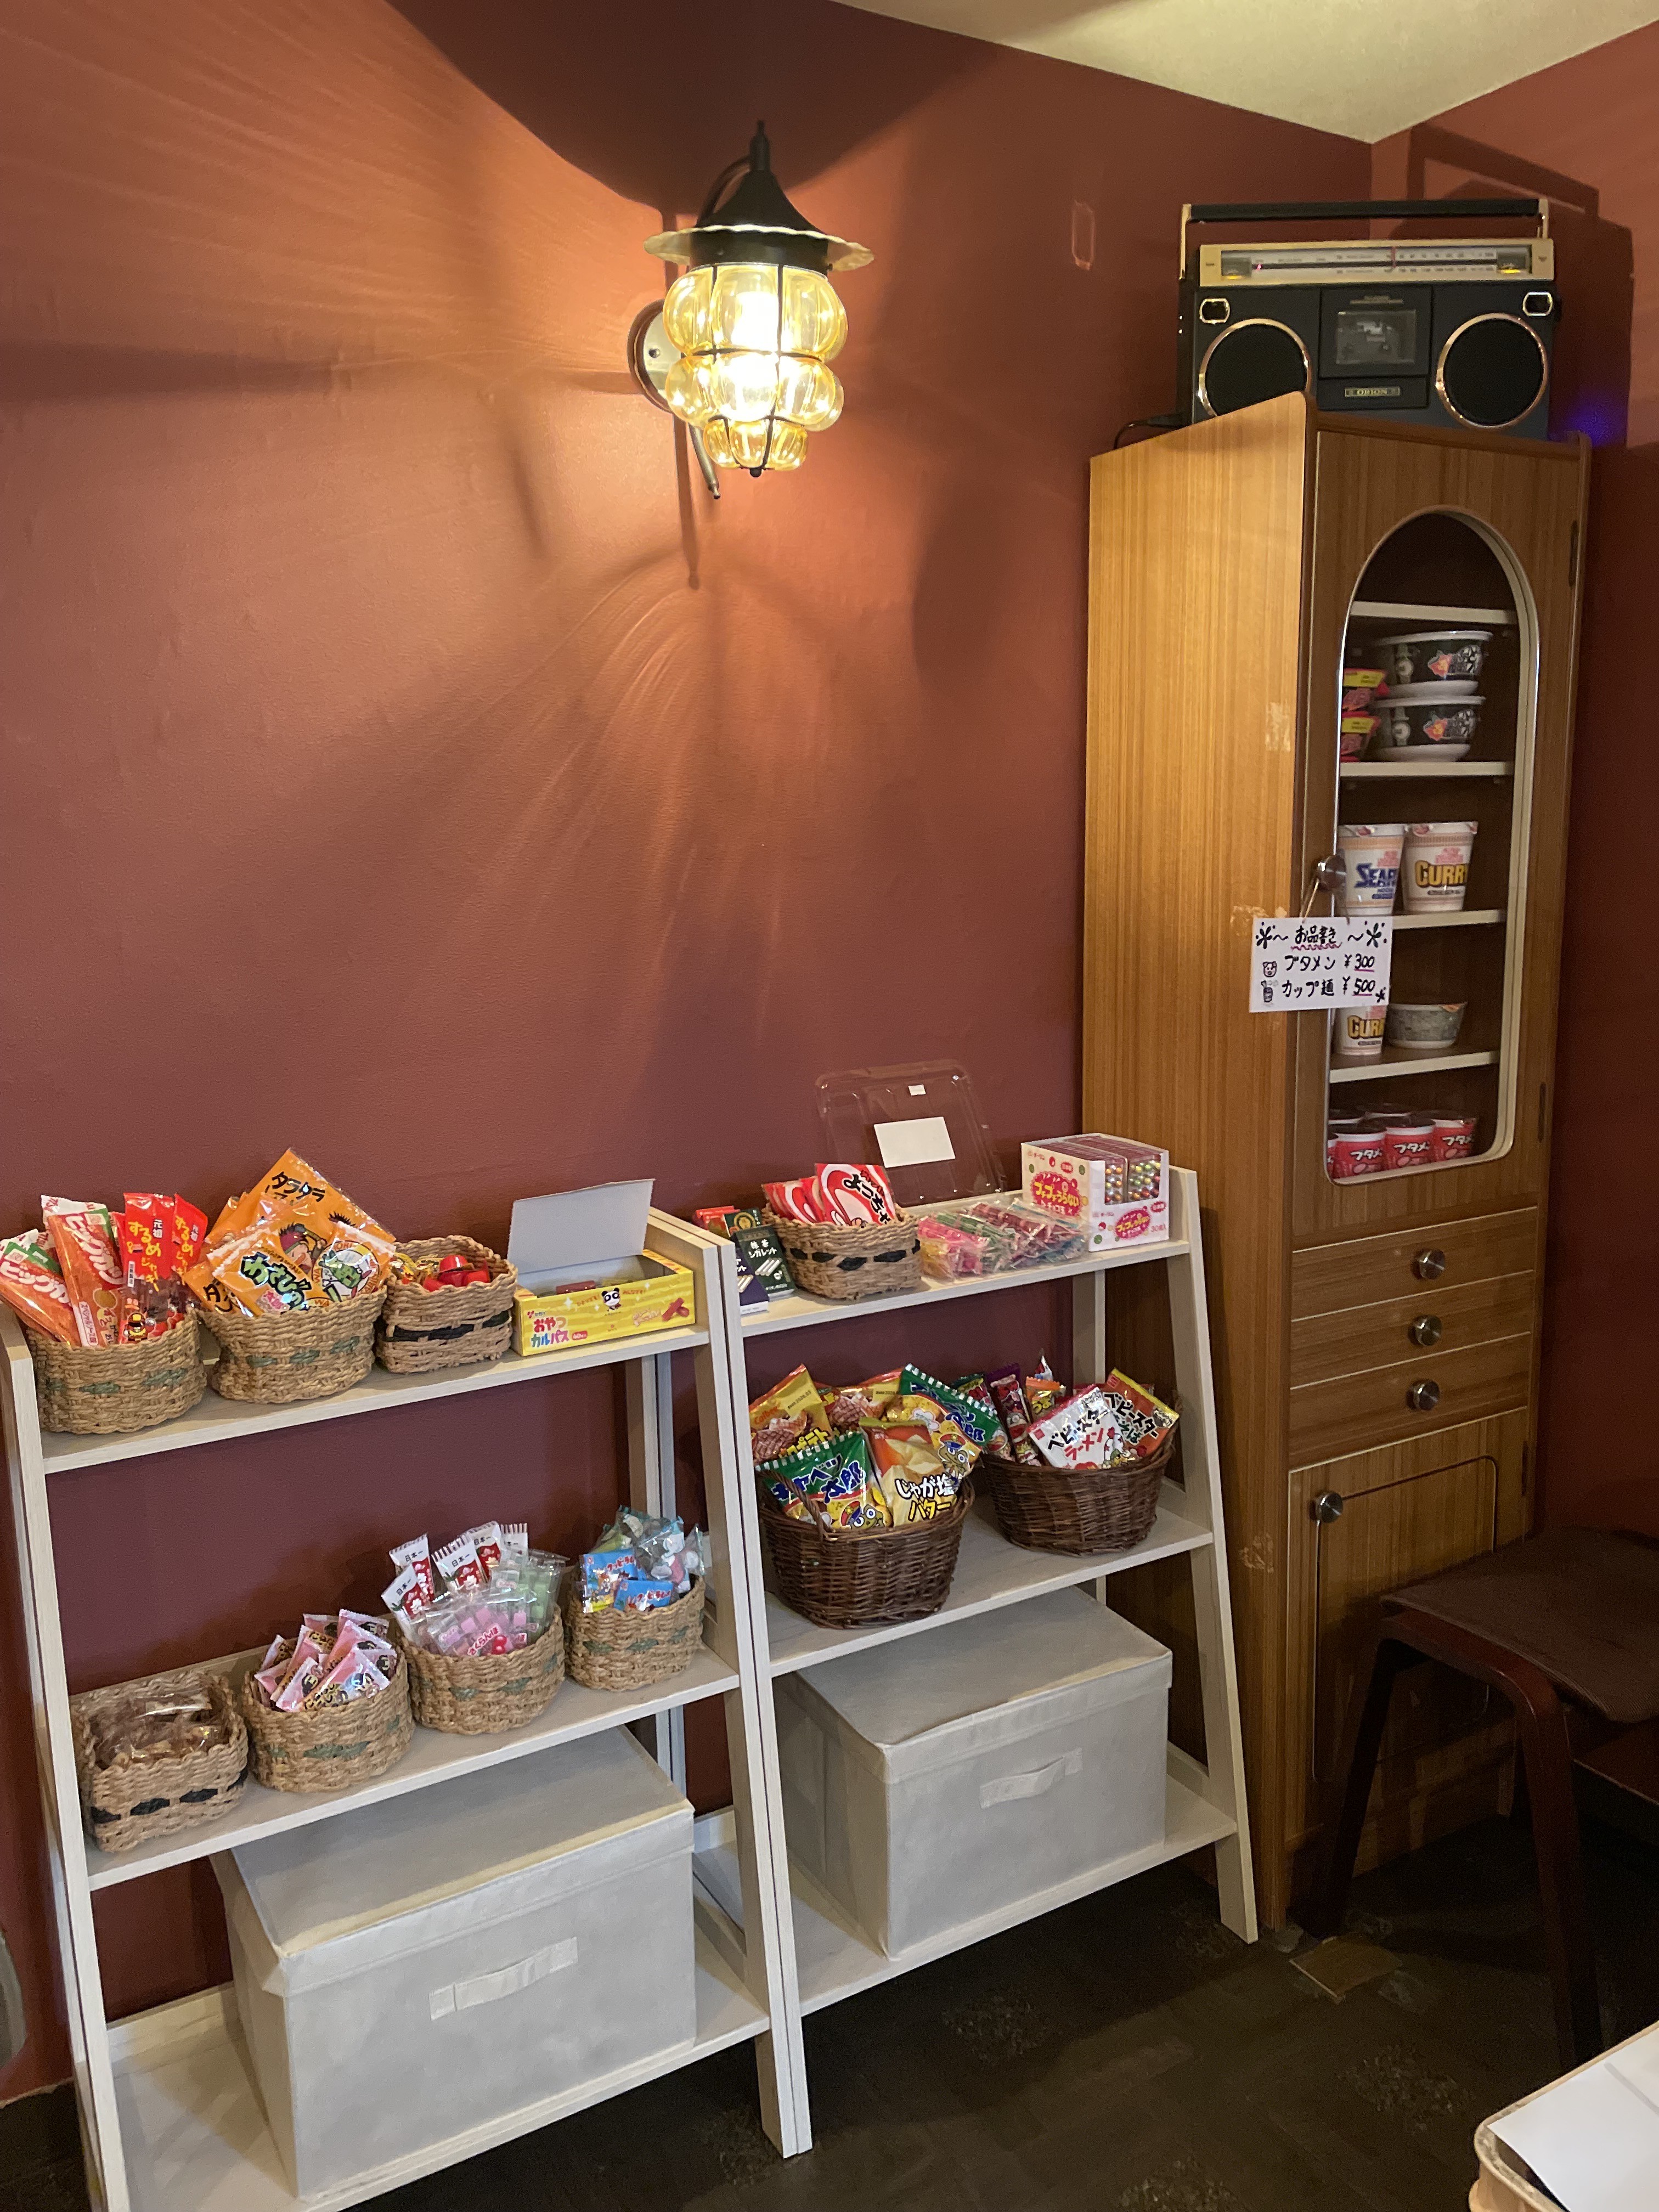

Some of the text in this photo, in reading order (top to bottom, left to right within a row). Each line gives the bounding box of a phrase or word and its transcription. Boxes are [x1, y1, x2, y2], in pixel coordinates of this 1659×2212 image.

[1284, 955, 1335, 971] ブタメン
[1282, 978, 1334, 998] カップ麺
[272, 1171, 325, 1202] タラタラ
[128, 1221, 161, 1257] するめ
[175, 1215, 193, 1257] するめ
[0, 1261, 71, 1304] ビッグカ
[534, 1317, 567, 1333] おやつ
[531, 1330, 569, 1347] カルパス
[1064, 1427, 1104, 1460] ラーメン
[821, 1460, 865, 1504] 太郎
[908, 1499, 951, 1522] バター
[474, 1536, 491, 1546] 日本一
[405, 1550, 424, 1562] 日本一
[451, 1554, 470, 1567] 日本一
[396, 1578, 413, 1596] 日本一
